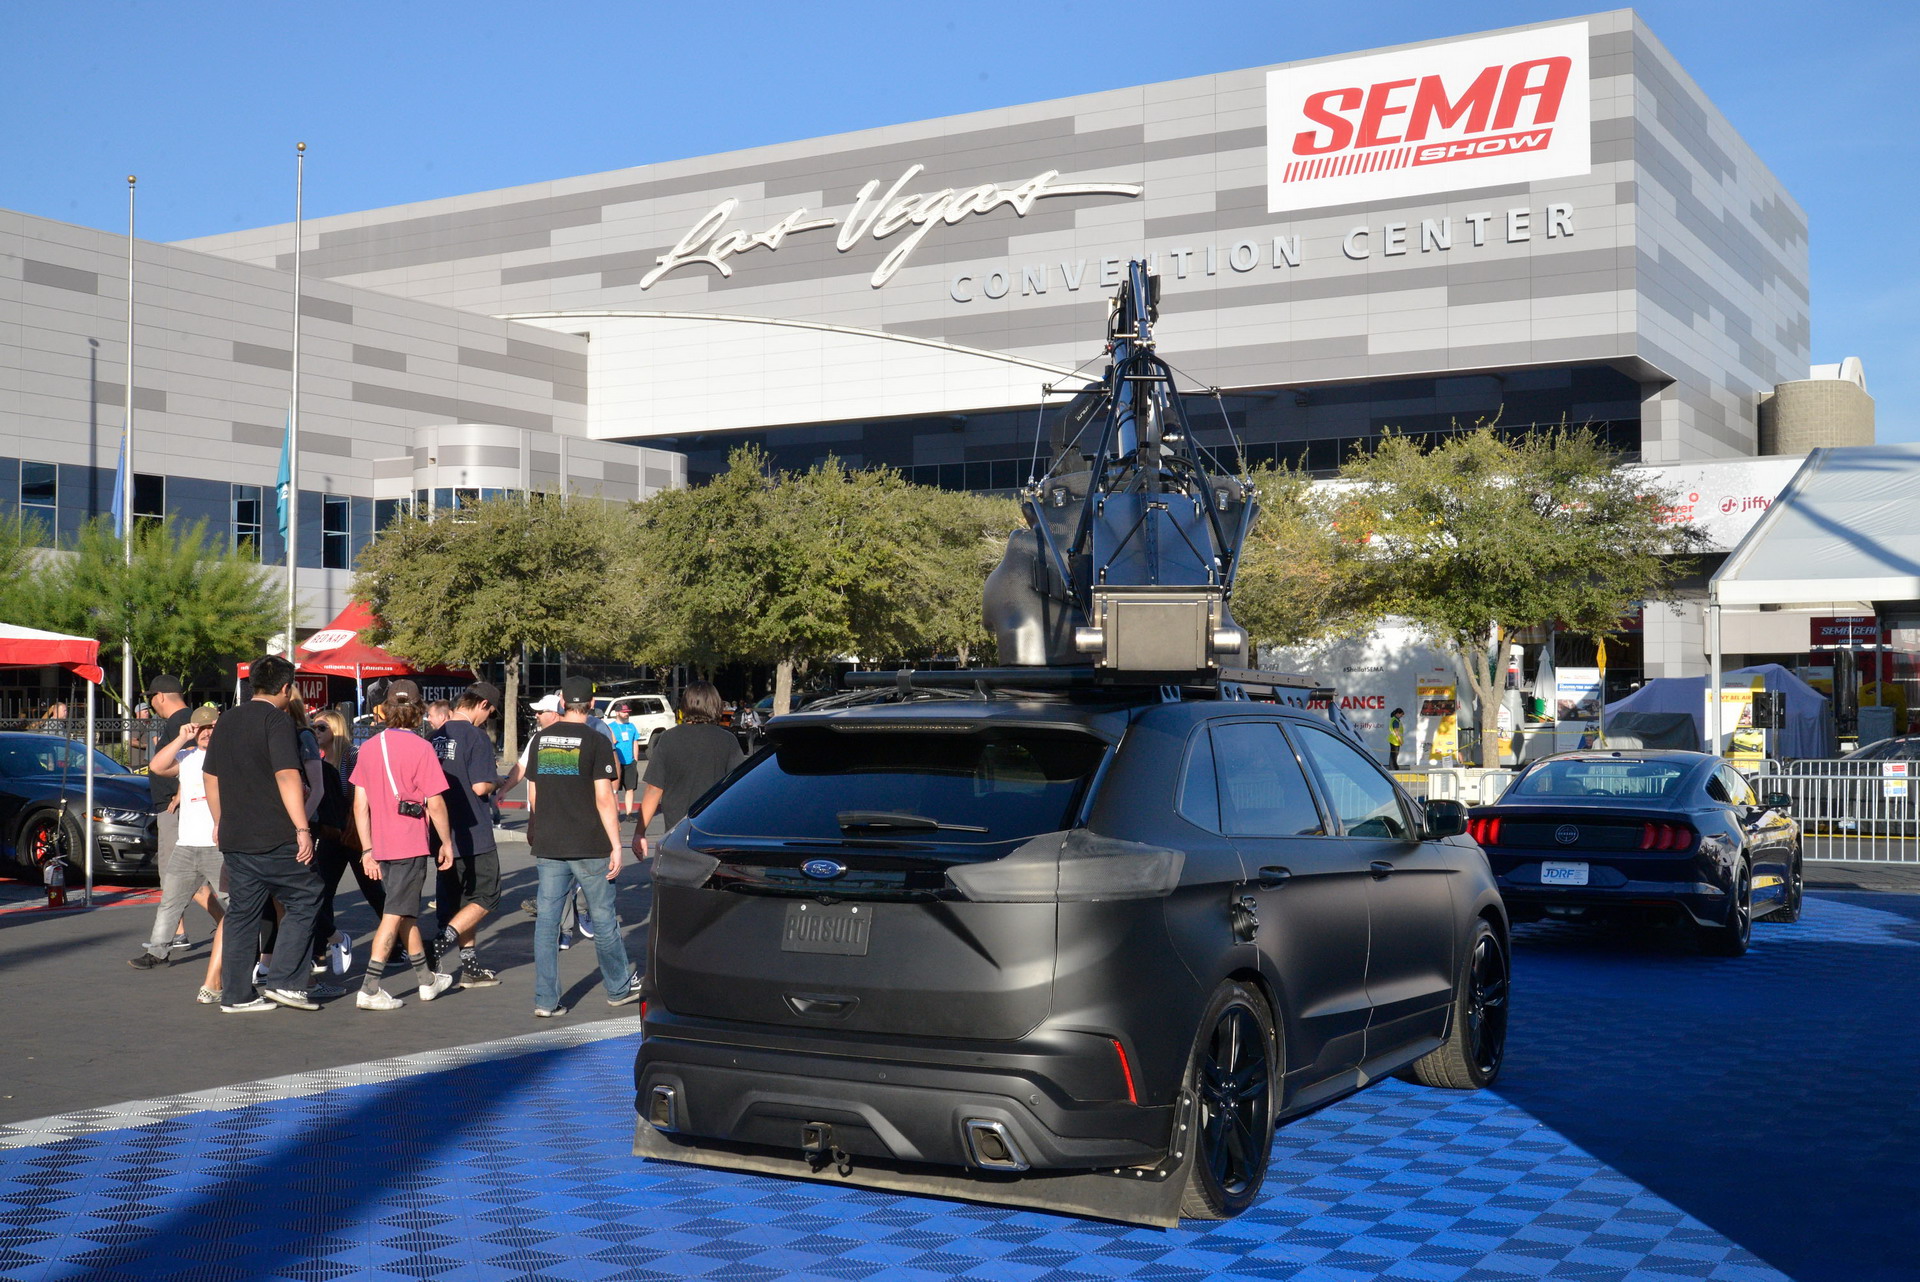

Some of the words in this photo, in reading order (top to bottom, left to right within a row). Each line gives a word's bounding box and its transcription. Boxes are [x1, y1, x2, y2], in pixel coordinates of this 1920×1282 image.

[1292, 56, 1573, 156] SEMA
[1418, 132, 1547, 162] SHOW
[640, 197, 838, 290] Las
[836, 163, 1145, 289] Vegas
[1342, 202, 1576, 261] CENTER
[312, 633, 329, 643] RED
[326, 632, 348, 643] KAP
[303, 681, 323, 699] KAP
[422, 686, 446, 701] TEST
[1543, 868, 1575, 879] JDRF
[786, 915, 866, 944] PURSUIT
